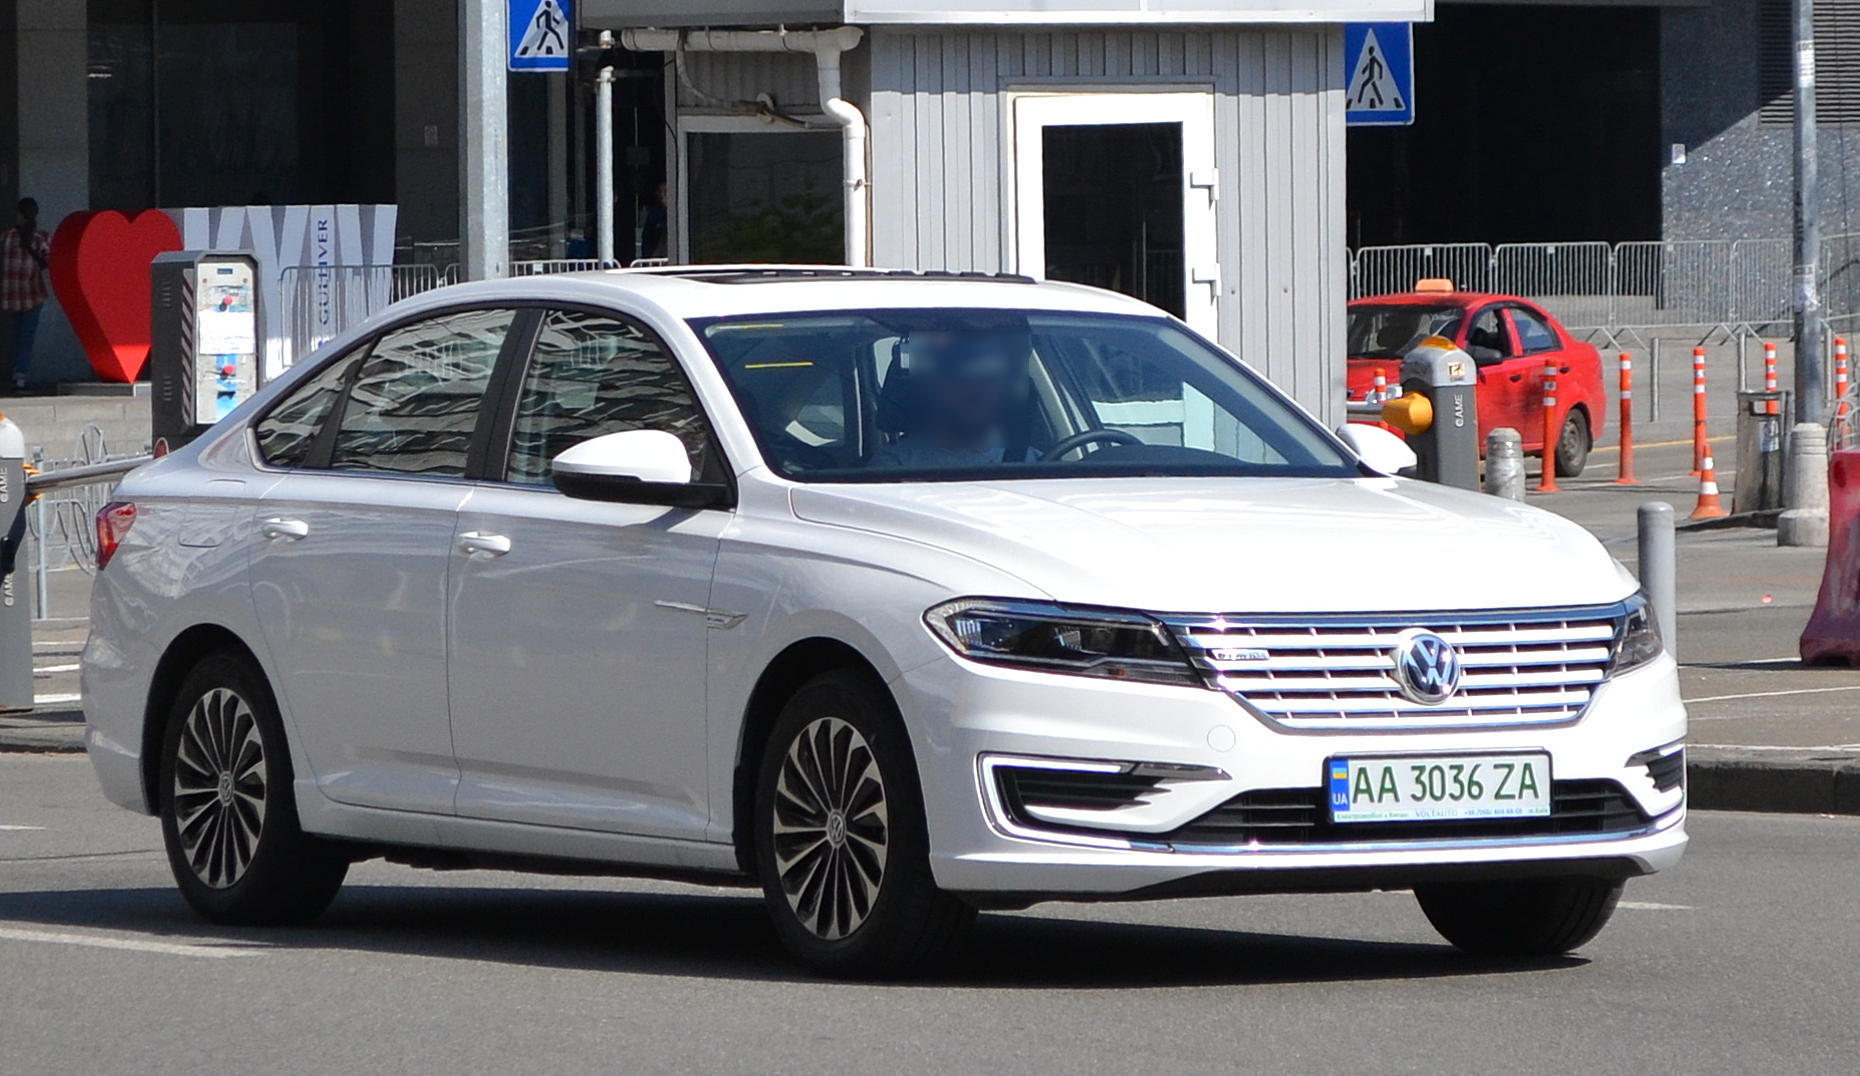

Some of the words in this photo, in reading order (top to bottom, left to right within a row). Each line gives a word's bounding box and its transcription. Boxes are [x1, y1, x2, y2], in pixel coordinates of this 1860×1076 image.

[318, 219, 329, 325] GULLIVER
[1333, 793, 1348, 806] UA
[1352, 766, 1400, 803] AA
[1411, 763, 1484, 801] 3036
[1493, 762, 1540, 800] ZA
